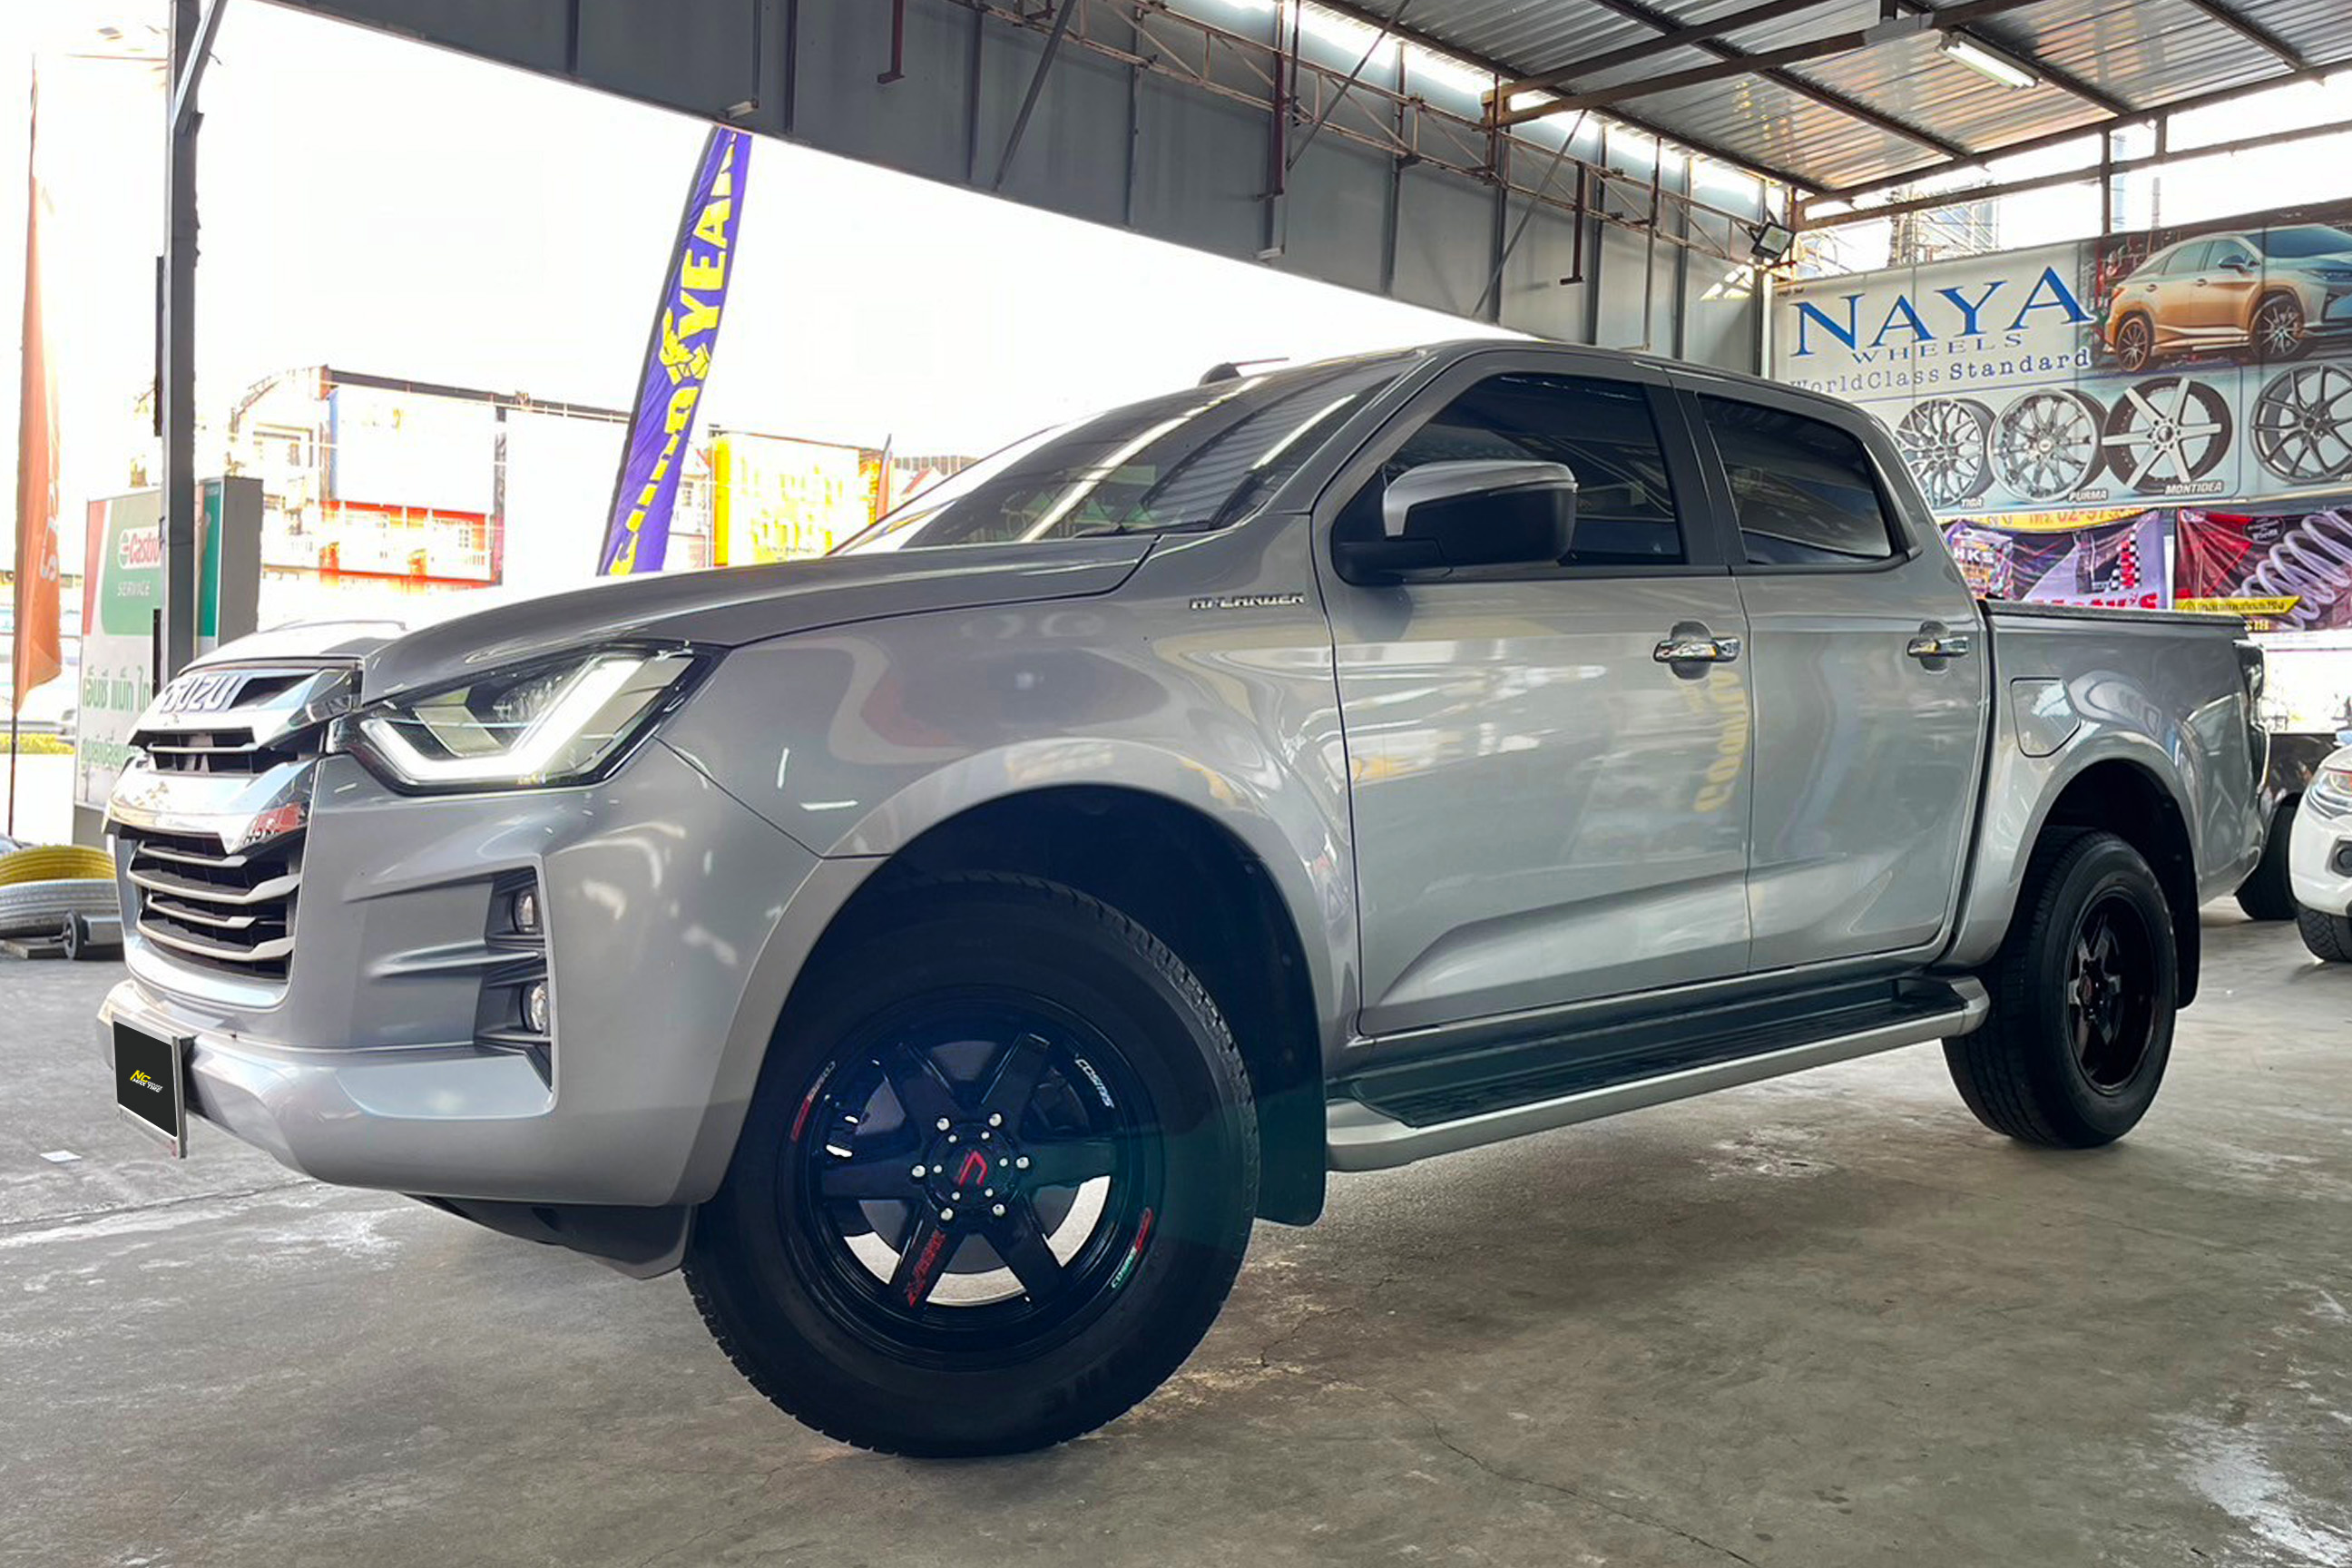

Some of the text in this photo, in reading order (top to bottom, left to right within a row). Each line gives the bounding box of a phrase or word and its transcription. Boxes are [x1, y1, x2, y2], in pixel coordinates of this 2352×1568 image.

[1789, 266, 2097, 357] NAYA
[1851, 333, 2023, 364] WHEELS
[1949, 349, 2091, 381] Standard
[2165, 481, 2223, 495] MONTIDEA
[130, 532, 161, 564] Castro
[1953, 547, 1994, 564] HKS
[117, 582, 151, 596] SERVICE
